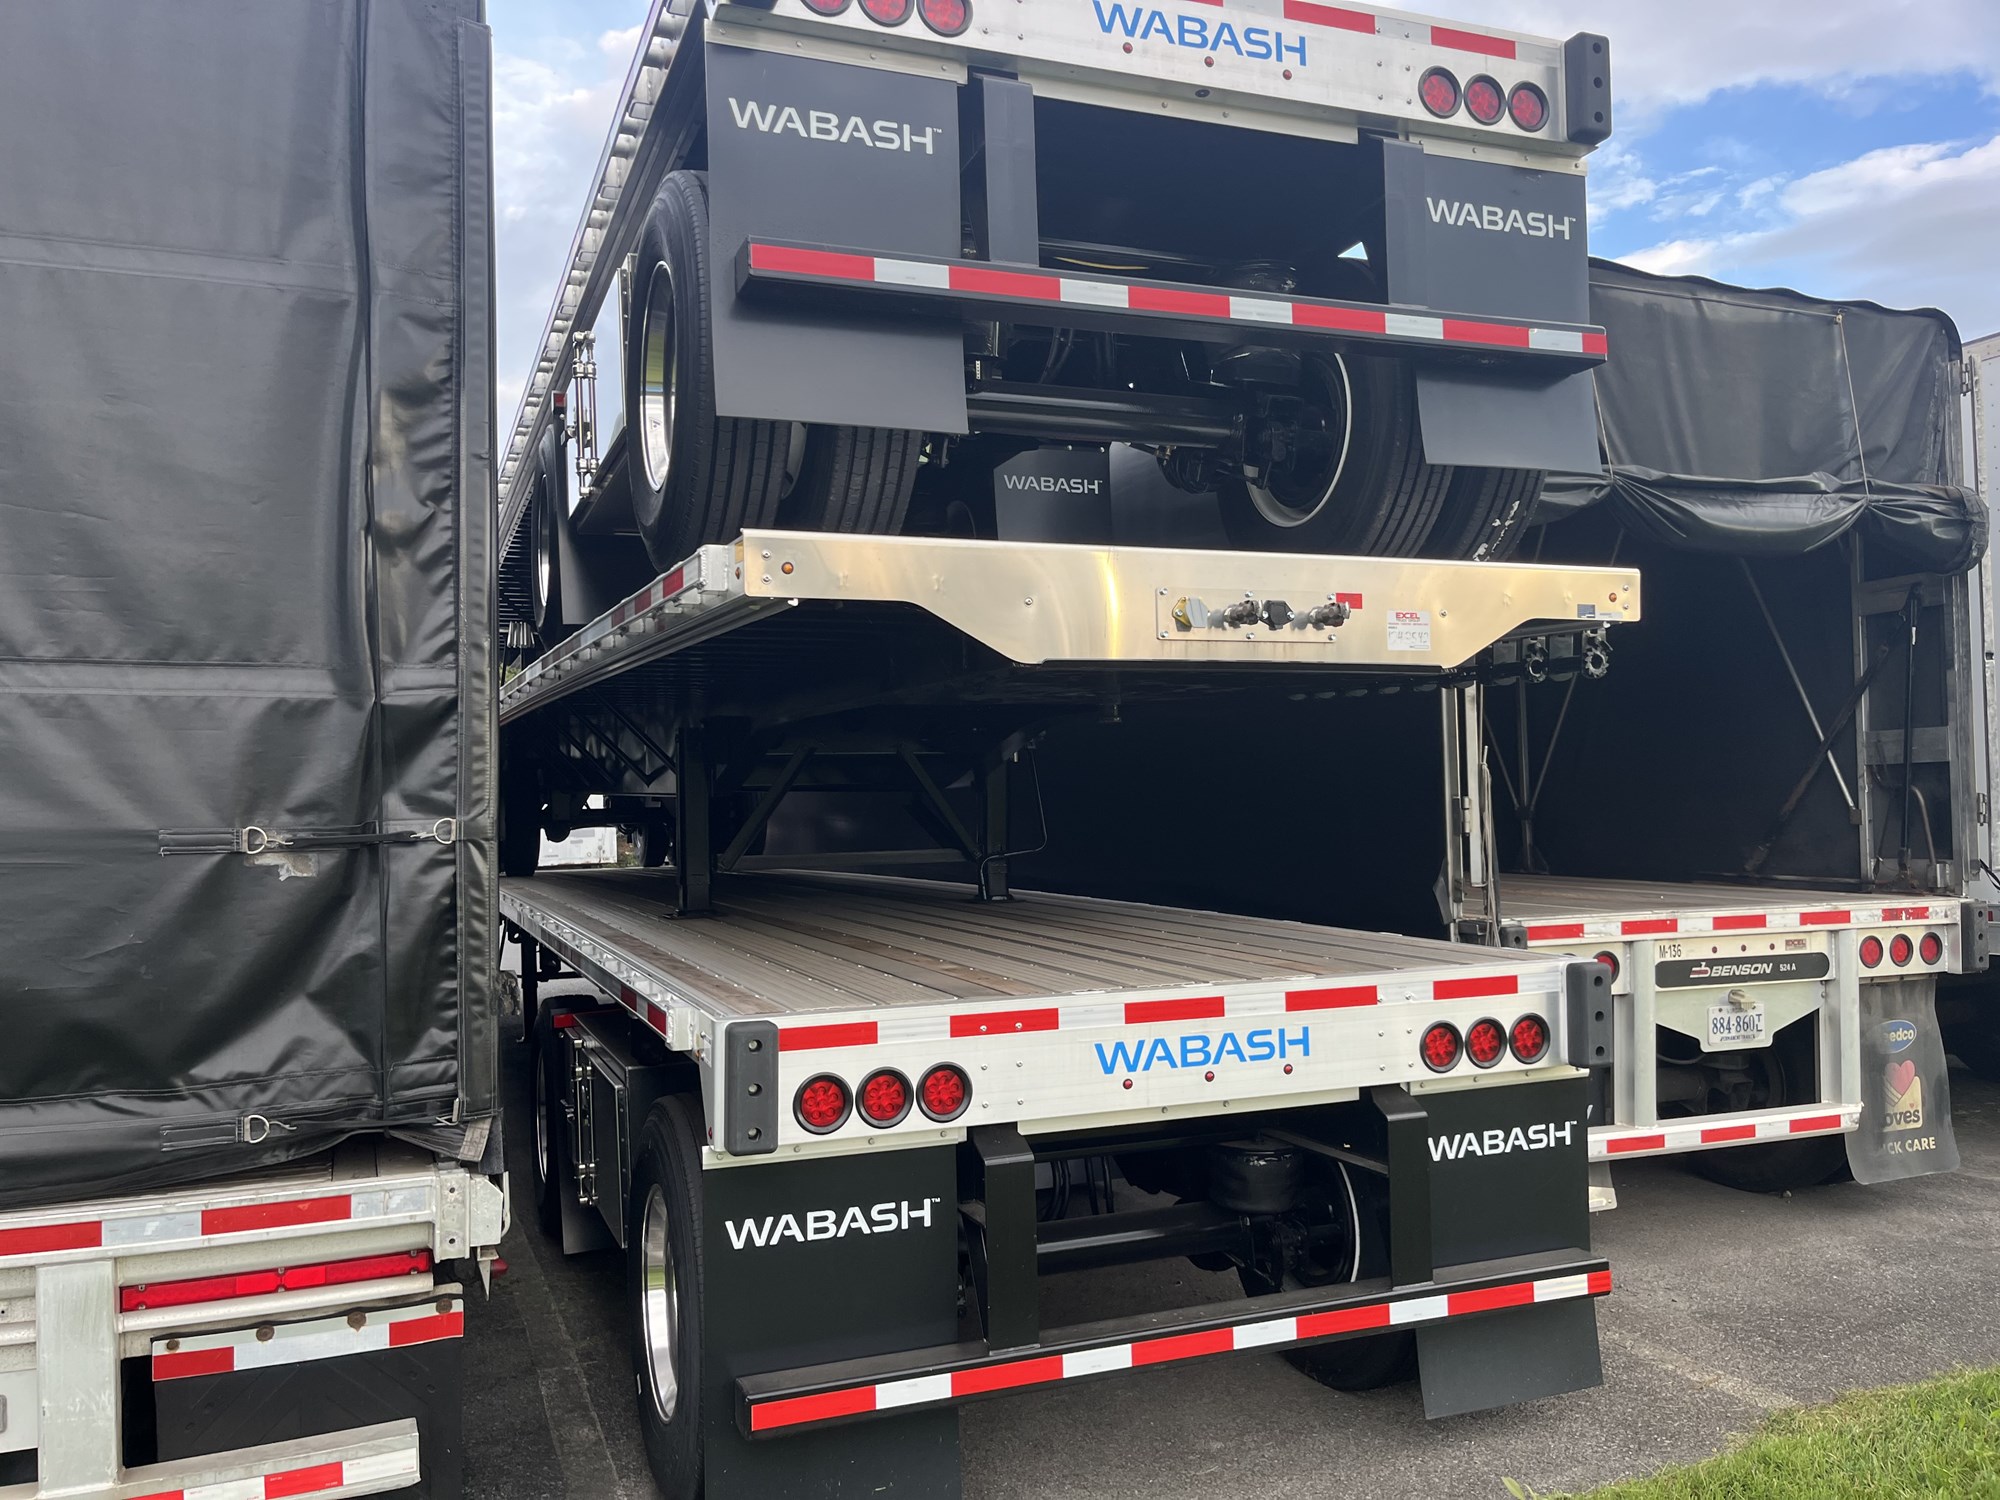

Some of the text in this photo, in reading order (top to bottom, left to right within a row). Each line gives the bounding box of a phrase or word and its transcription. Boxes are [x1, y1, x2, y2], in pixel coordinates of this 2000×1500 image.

[1094, 0, 1307, 67] WABASH
[1395, 612, 1420, 620] EXCEL
[1658, 944, 1682, 959] M-136
[1710, 962, 1797, 977] BENSON 524 A
[1094, 1026, 1311, 1075] WABASH
[1905, 1136, 1937, 1152] CARE
